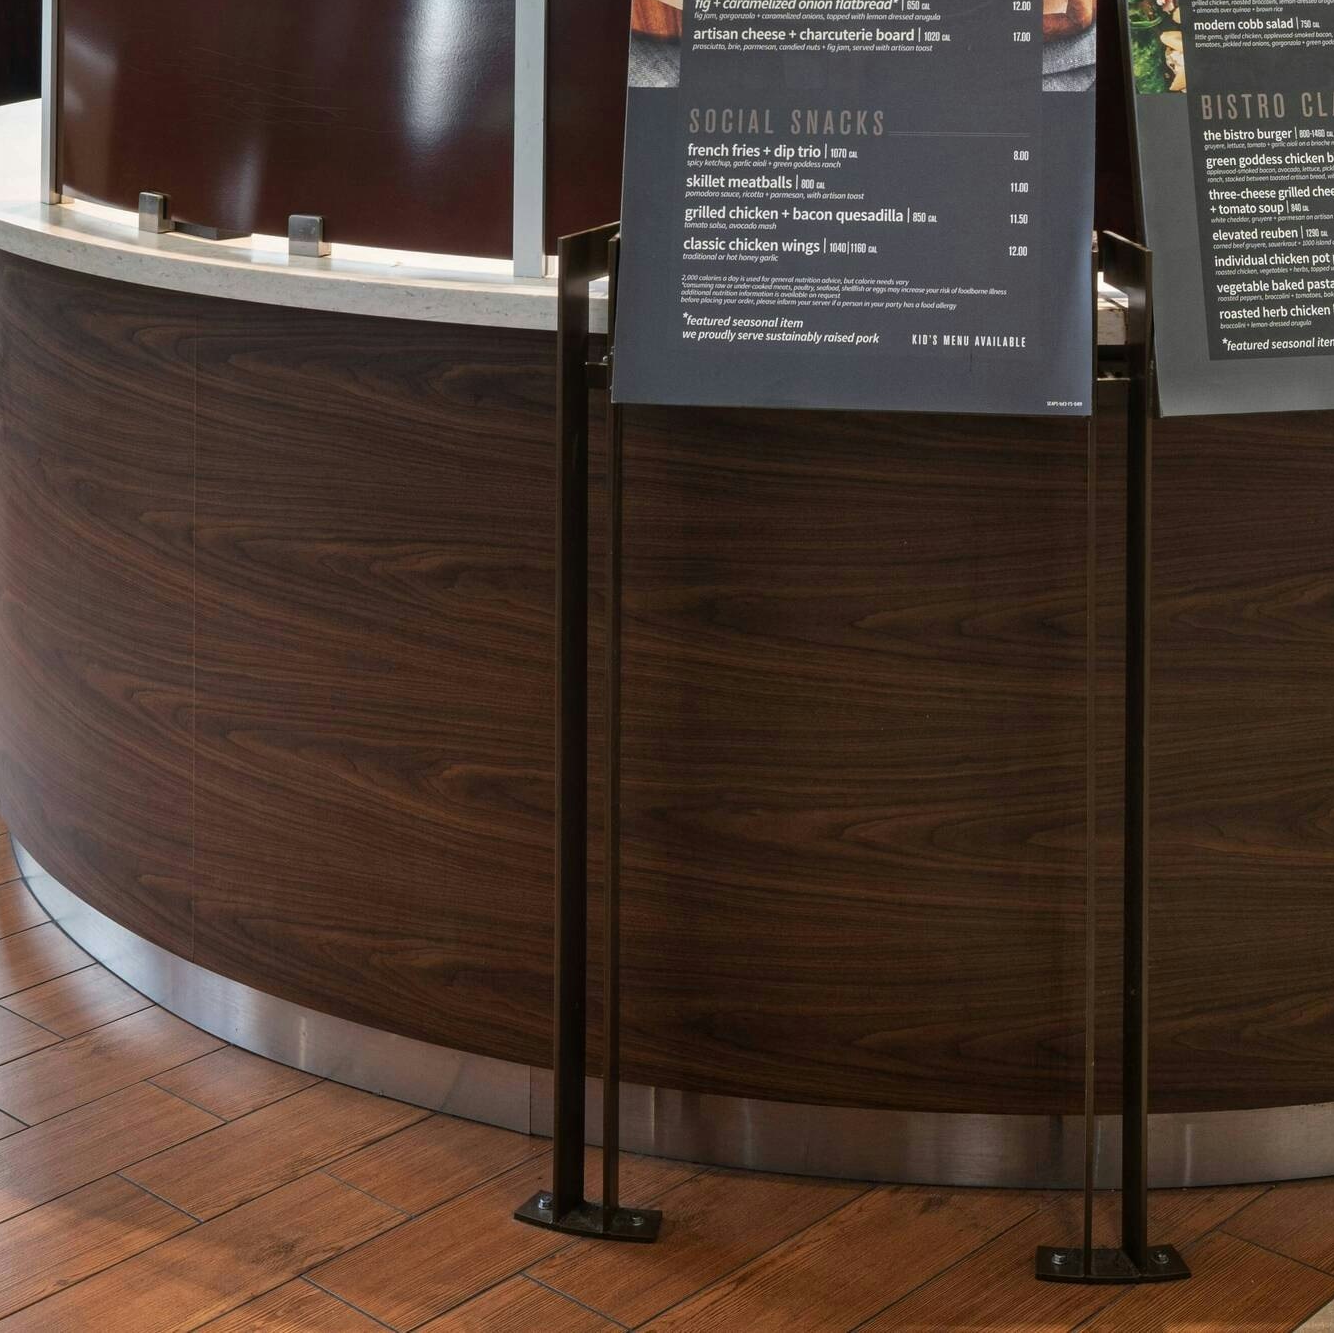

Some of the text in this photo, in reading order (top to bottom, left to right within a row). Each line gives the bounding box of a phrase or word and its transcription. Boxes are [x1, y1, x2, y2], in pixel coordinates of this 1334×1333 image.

[693, 27, 1031, 42] artisan cheese charcuterie board 1020 17.00
[1201, 92, 1285, 120] BISTRO
[689, 108, 884, 136] SOCIAL SNACKS
[1203, 130, 1222, 141] the
[1223, 129, 1255, 140] bistro
[1256, 128, 1293, 142] burger
[687, 143, 1029, 161] french fries dip trio 8.00
[686, 174, 792, 189] skillet meatballs
[1208, 188, 1276, 201] three-cheese
[1278, 186, 1311, 200] grilled
[1218, 203, 1284, 215] tomato soup
[1212, 227, 1299, 241] elevated reuben
[683, 236, 1028, 257] classic chicken wings 12.00
[1219, 306, 1261, 320] roasted
[1262, 305, 1288, 318] herb
[1290, 304, 1331, 317] chicken
[732, 317, 779, 328] seasonal
[780, 317, 804, 328] item
[682, 329, 880, 345] we proudly serve sustainably raised pork
[912, 334, 1026, 348] KID'S MENU AVAILABLE
